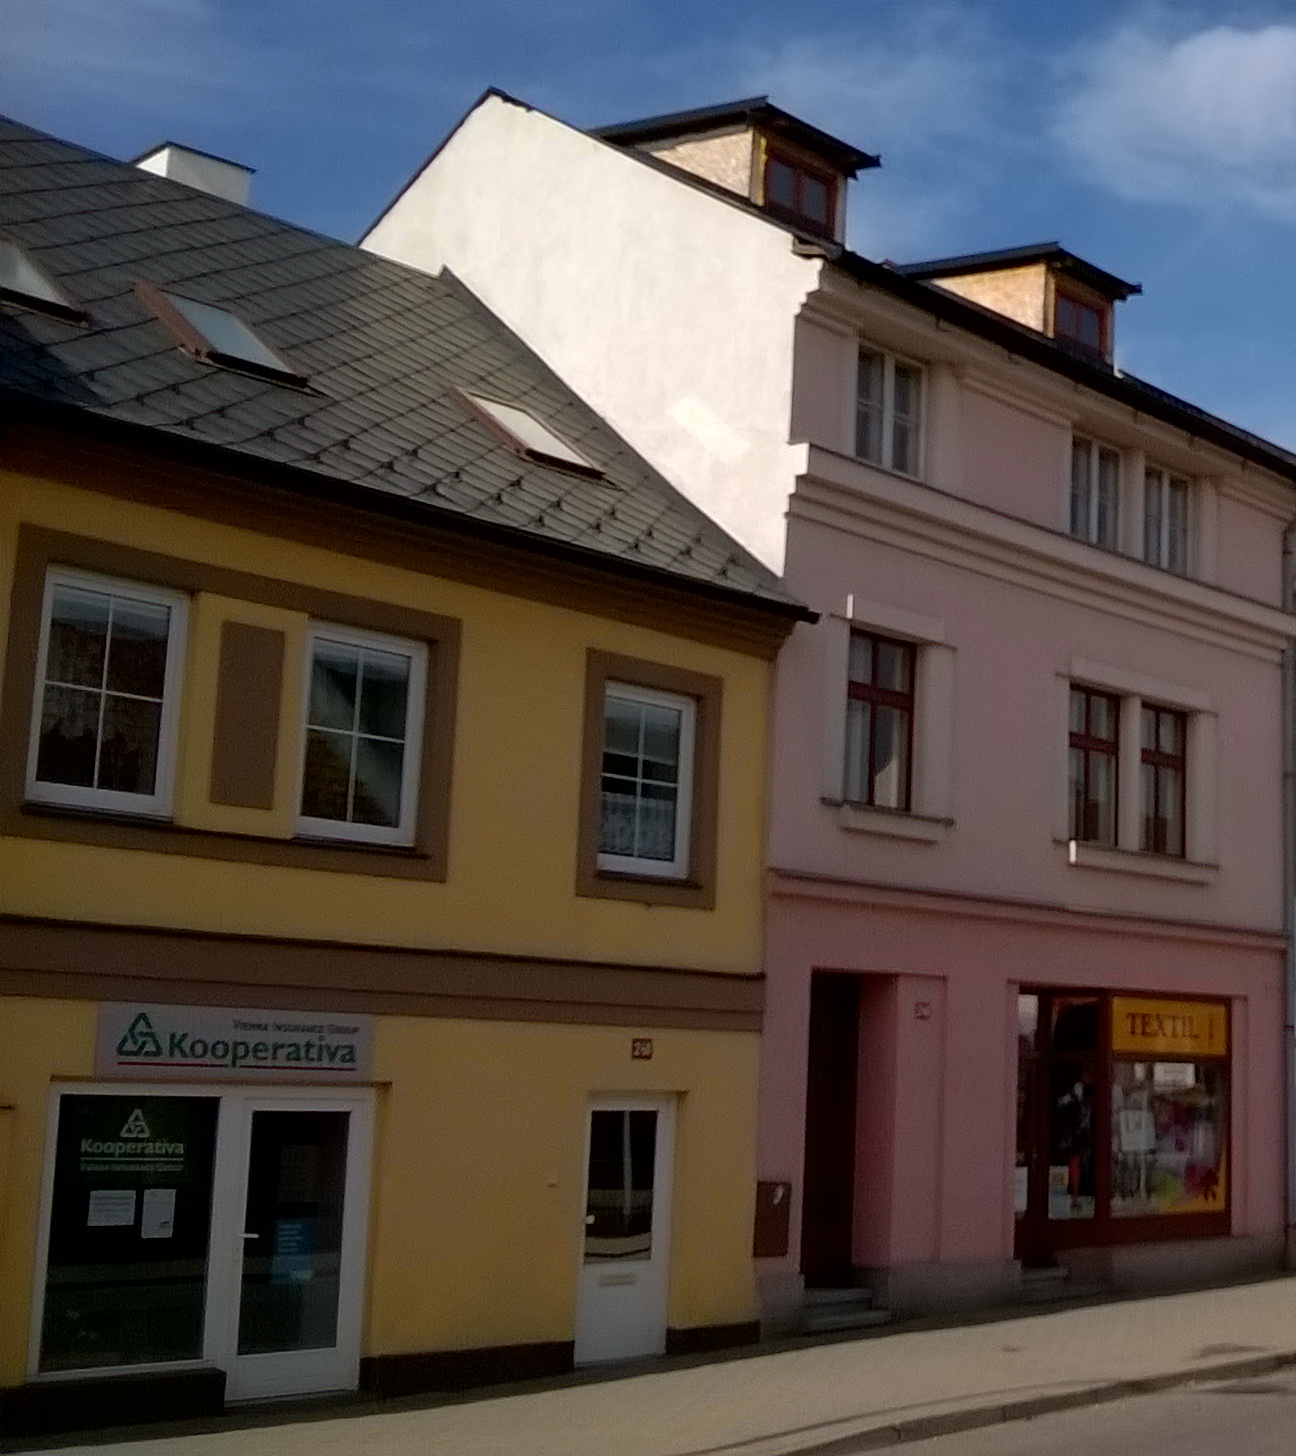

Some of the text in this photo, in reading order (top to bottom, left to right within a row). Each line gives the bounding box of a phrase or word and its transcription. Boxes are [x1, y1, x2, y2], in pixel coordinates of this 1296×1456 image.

[1126, 1012, 1200, 1039] TEXTIL
[169, 1033, 357, 1067] Kooperativa
[80, 1138, 185, 1158] Kooperativa
